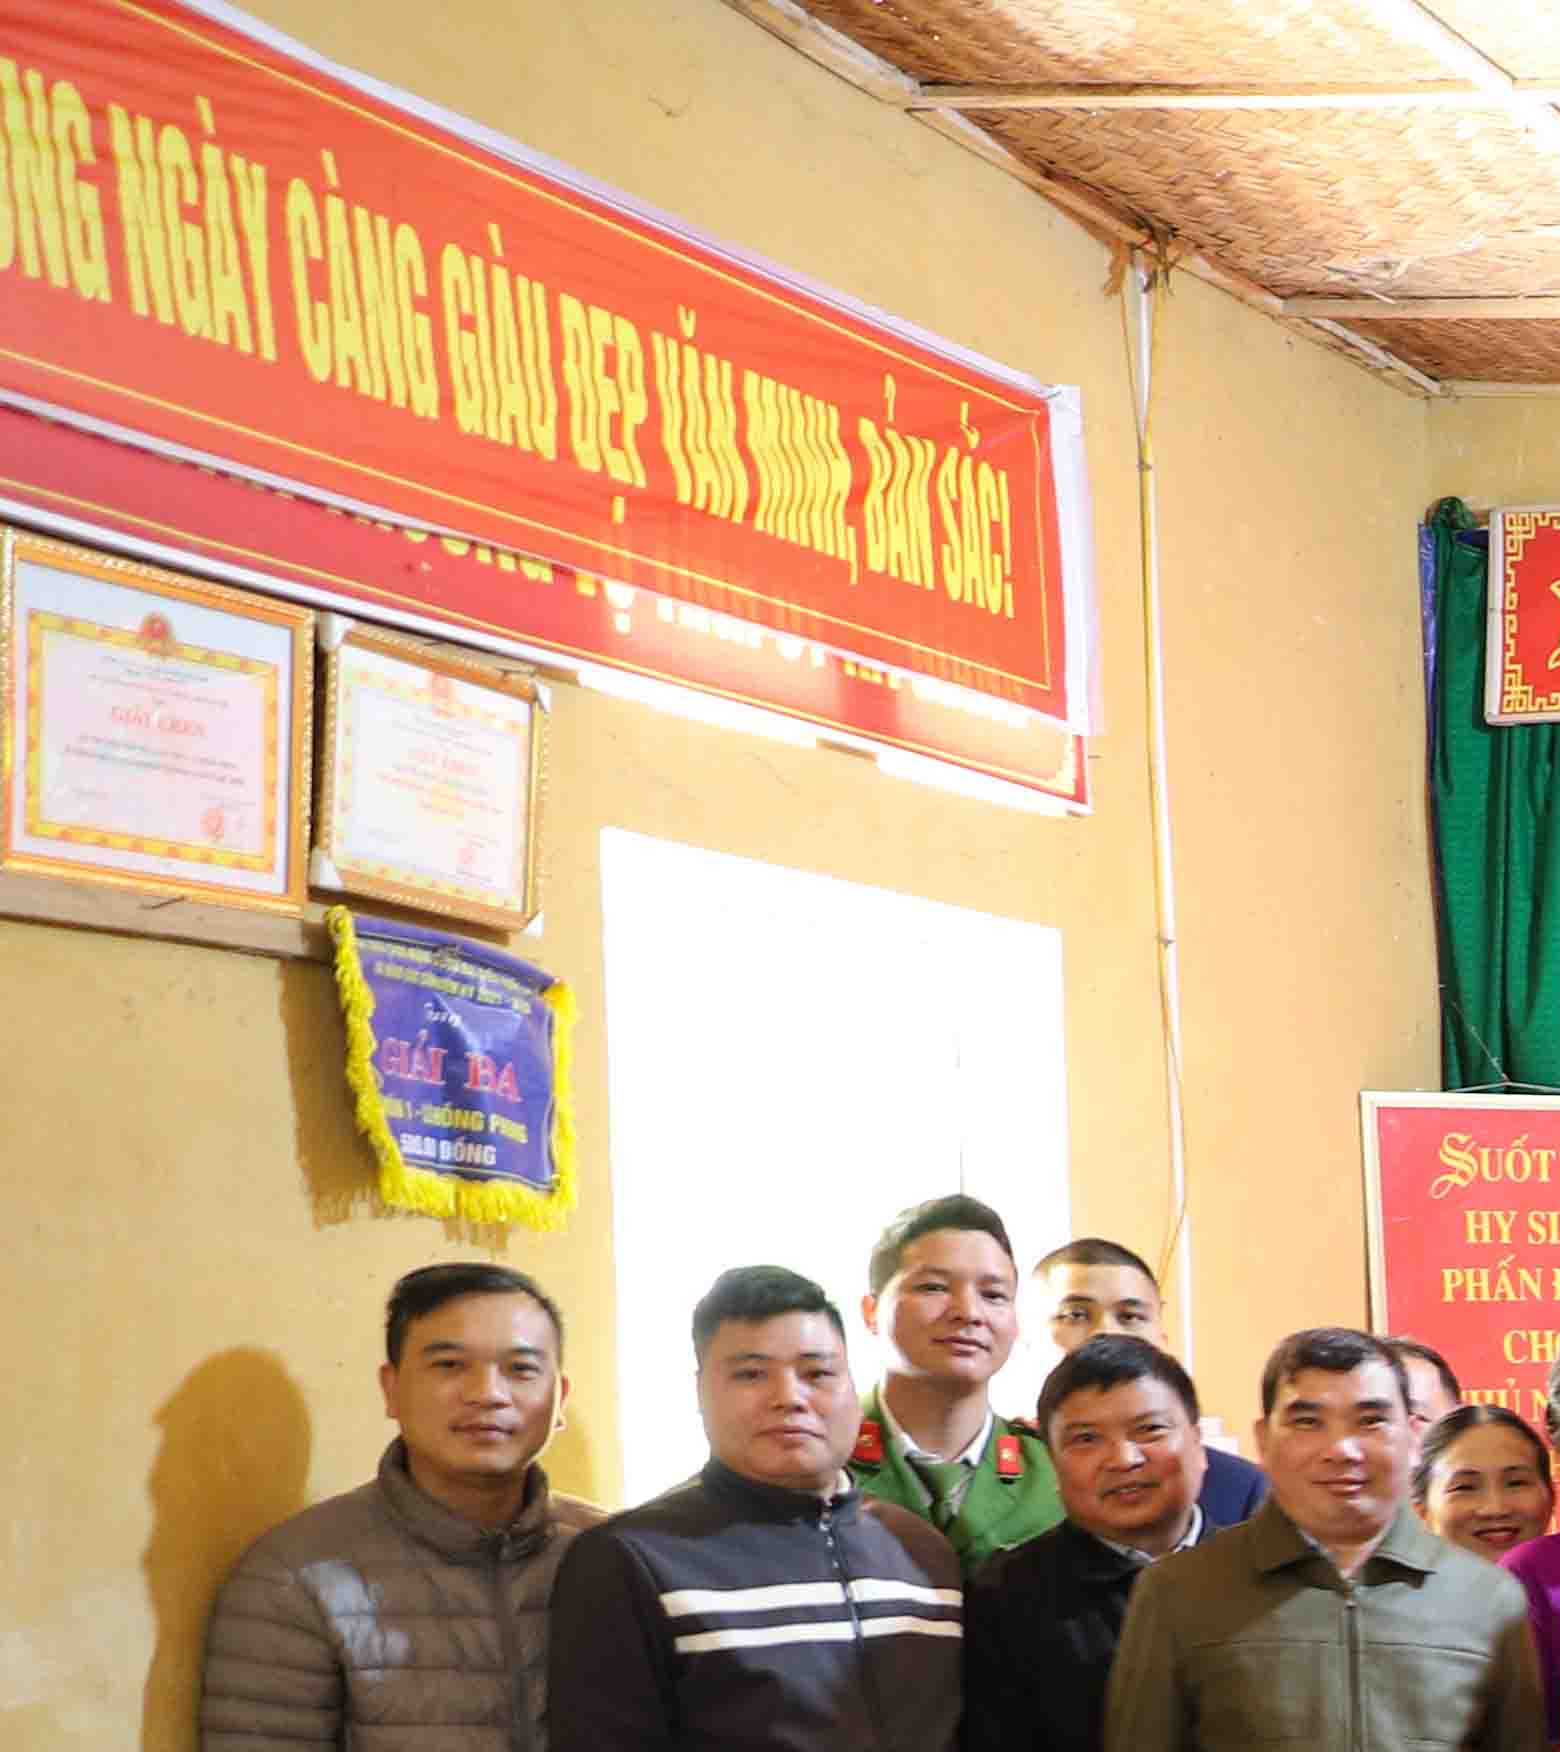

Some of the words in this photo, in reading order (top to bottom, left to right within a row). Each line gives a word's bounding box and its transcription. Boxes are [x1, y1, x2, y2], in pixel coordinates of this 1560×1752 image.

[108, 96, 277, 362] NGÀY
[285, 148, 439, 419] CÀNG
[441, 222, 557, 461] GIÀU
[560, 293, 648, 524] ĐẸP
[652, 305, 748, 523] VĂN
[744, 369, 857, 584] MINH,
[859, 373, 935, 589] BẢN
[936, 401, 1014, 618] SẮC!
[1430, 1132, 1556, 1199] SUỐT
[1465, 1210, 1517, 1245] HY
[1441, 1255, 1541, 1302] PHẤN
